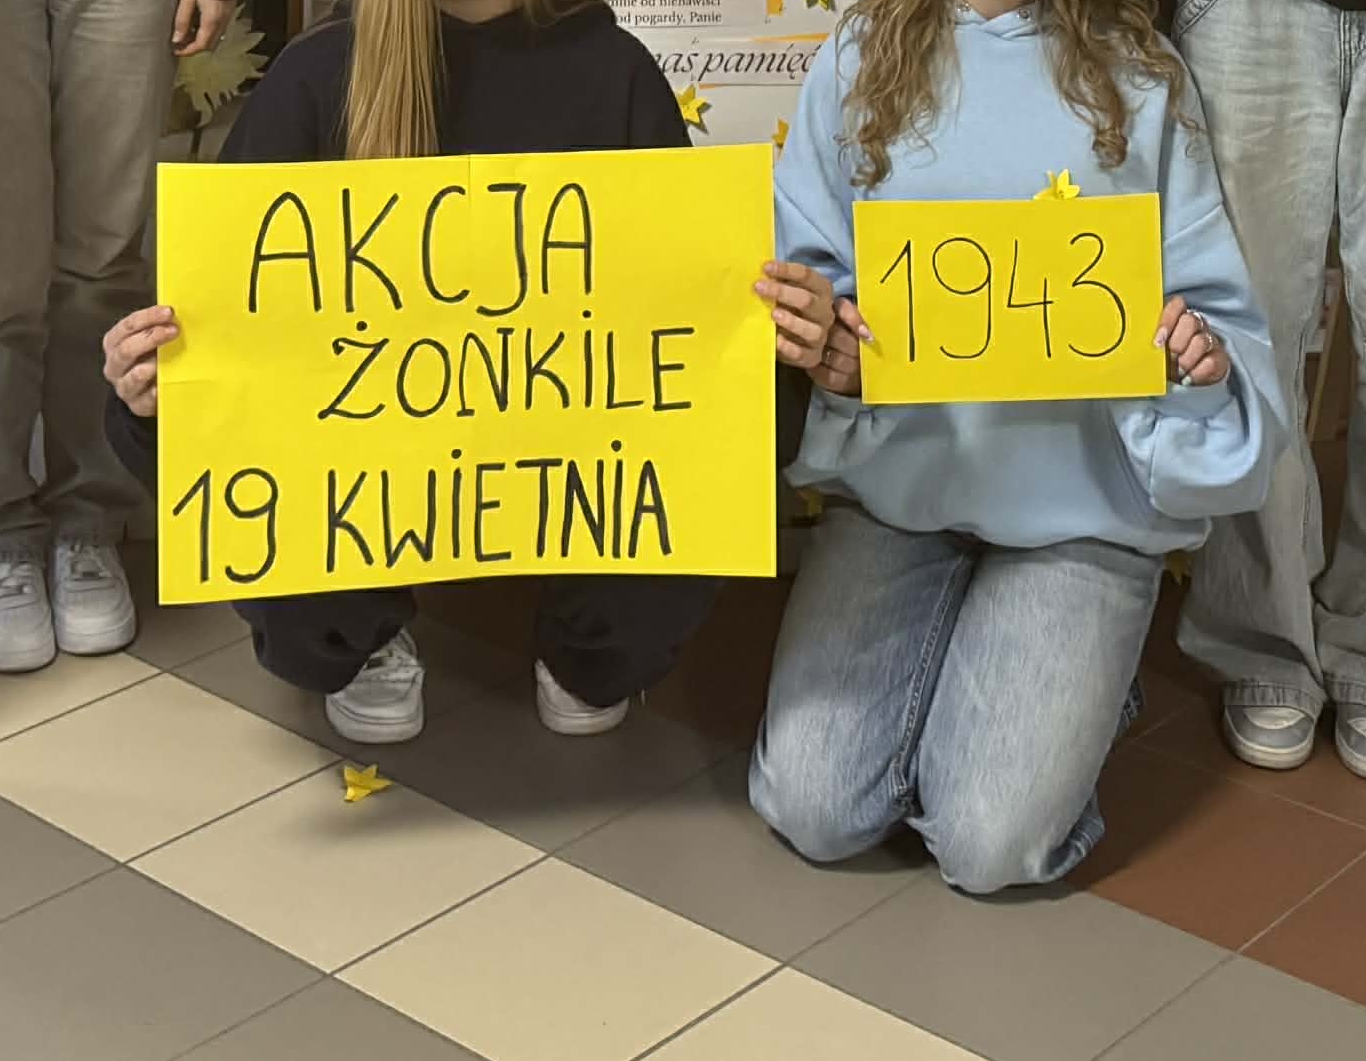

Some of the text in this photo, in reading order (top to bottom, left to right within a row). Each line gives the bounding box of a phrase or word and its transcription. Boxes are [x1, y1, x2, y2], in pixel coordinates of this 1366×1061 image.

[617, 10, 722, 26] od pogardy, Panie
[248, 182, 592, 317] AKCJA
[879, 232, 1126, 363] 1943
[172, 439, 673, 584] 19 KWIETNIA
